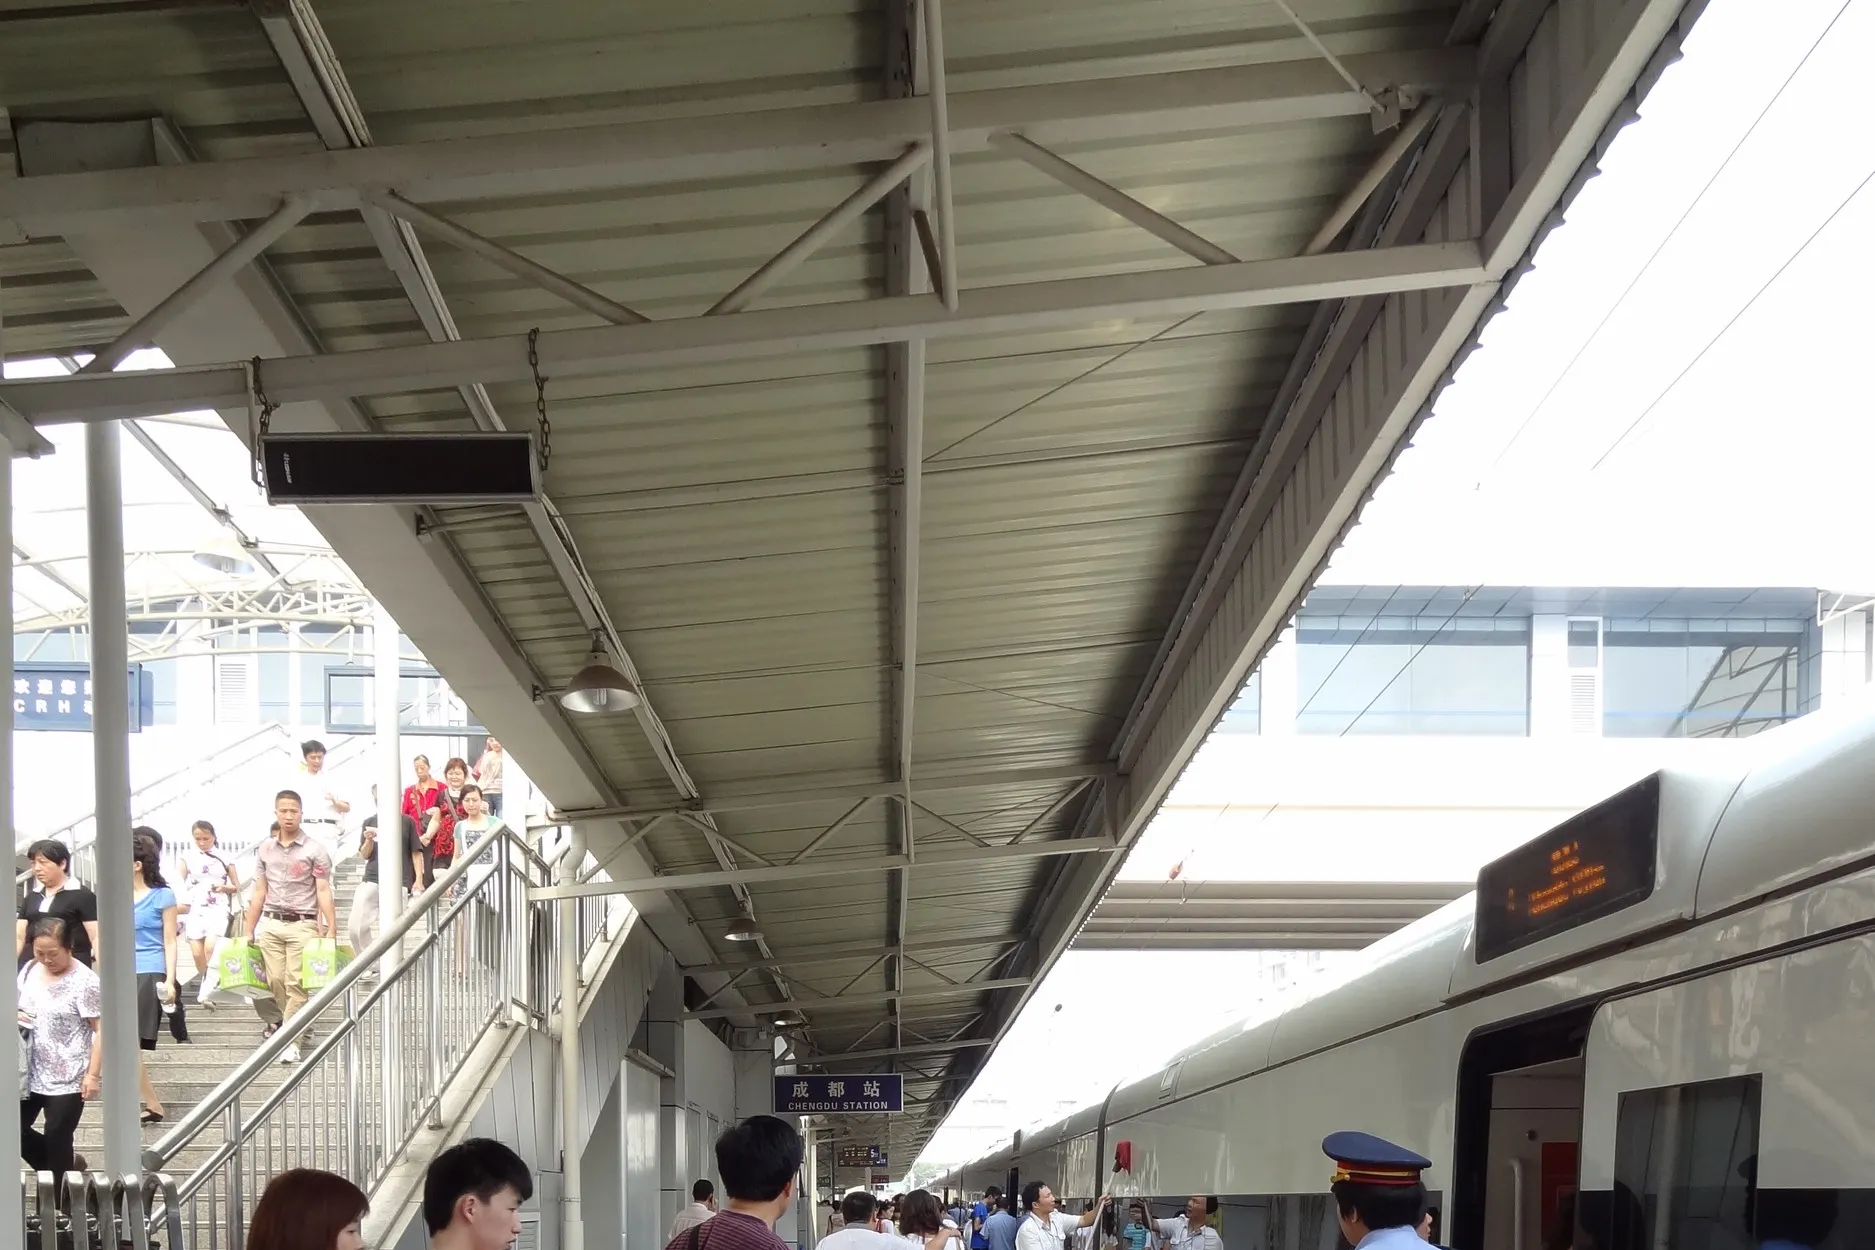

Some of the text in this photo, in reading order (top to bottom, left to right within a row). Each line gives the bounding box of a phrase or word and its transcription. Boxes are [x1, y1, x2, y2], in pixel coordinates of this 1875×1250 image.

[792, 1081, 881, 1098] 成都站
[788, 1101, 888, 1110] CHENGDU STATION
